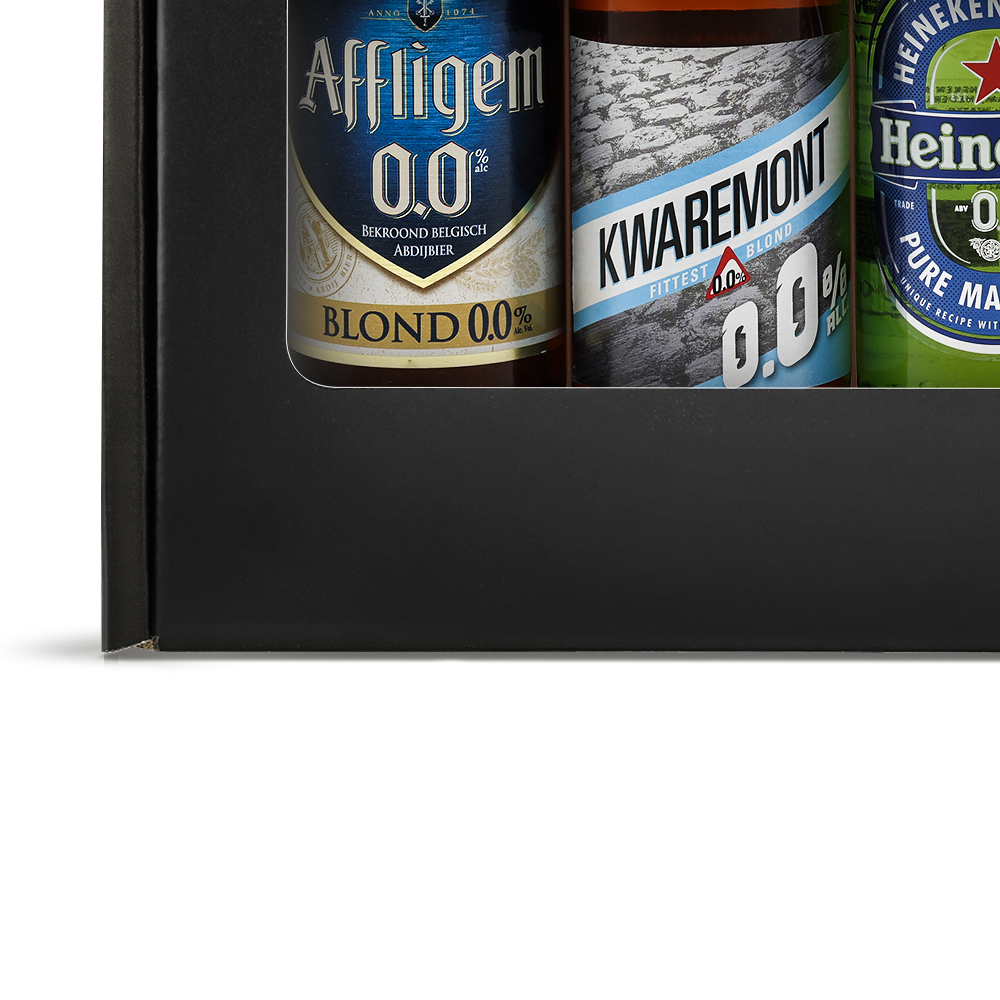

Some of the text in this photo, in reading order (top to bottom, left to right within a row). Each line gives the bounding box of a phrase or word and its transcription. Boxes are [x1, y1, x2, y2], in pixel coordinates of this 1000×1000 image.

[446, 8, 475, 16] 1074
[299, 36, 545, 136] Affligem
[950, 92, 970, 101] EST.
[475, 163, 488, 172] alc
[600, 117, 829, 289] KWAREMONT
[894, 200, 915, 210] TRADE
[954, 205, 969, 213] ABV
[432, 224, 486, 237] BELGISCH
[650, 222, 793, 298] FITTEST BLOND
[899, 231, 952, 297] PURE
[900, 277, 931, 312] UNIQUE
[935, 308, 973, 328] RECIPE
[322, 305, 459, 344] BLOND
